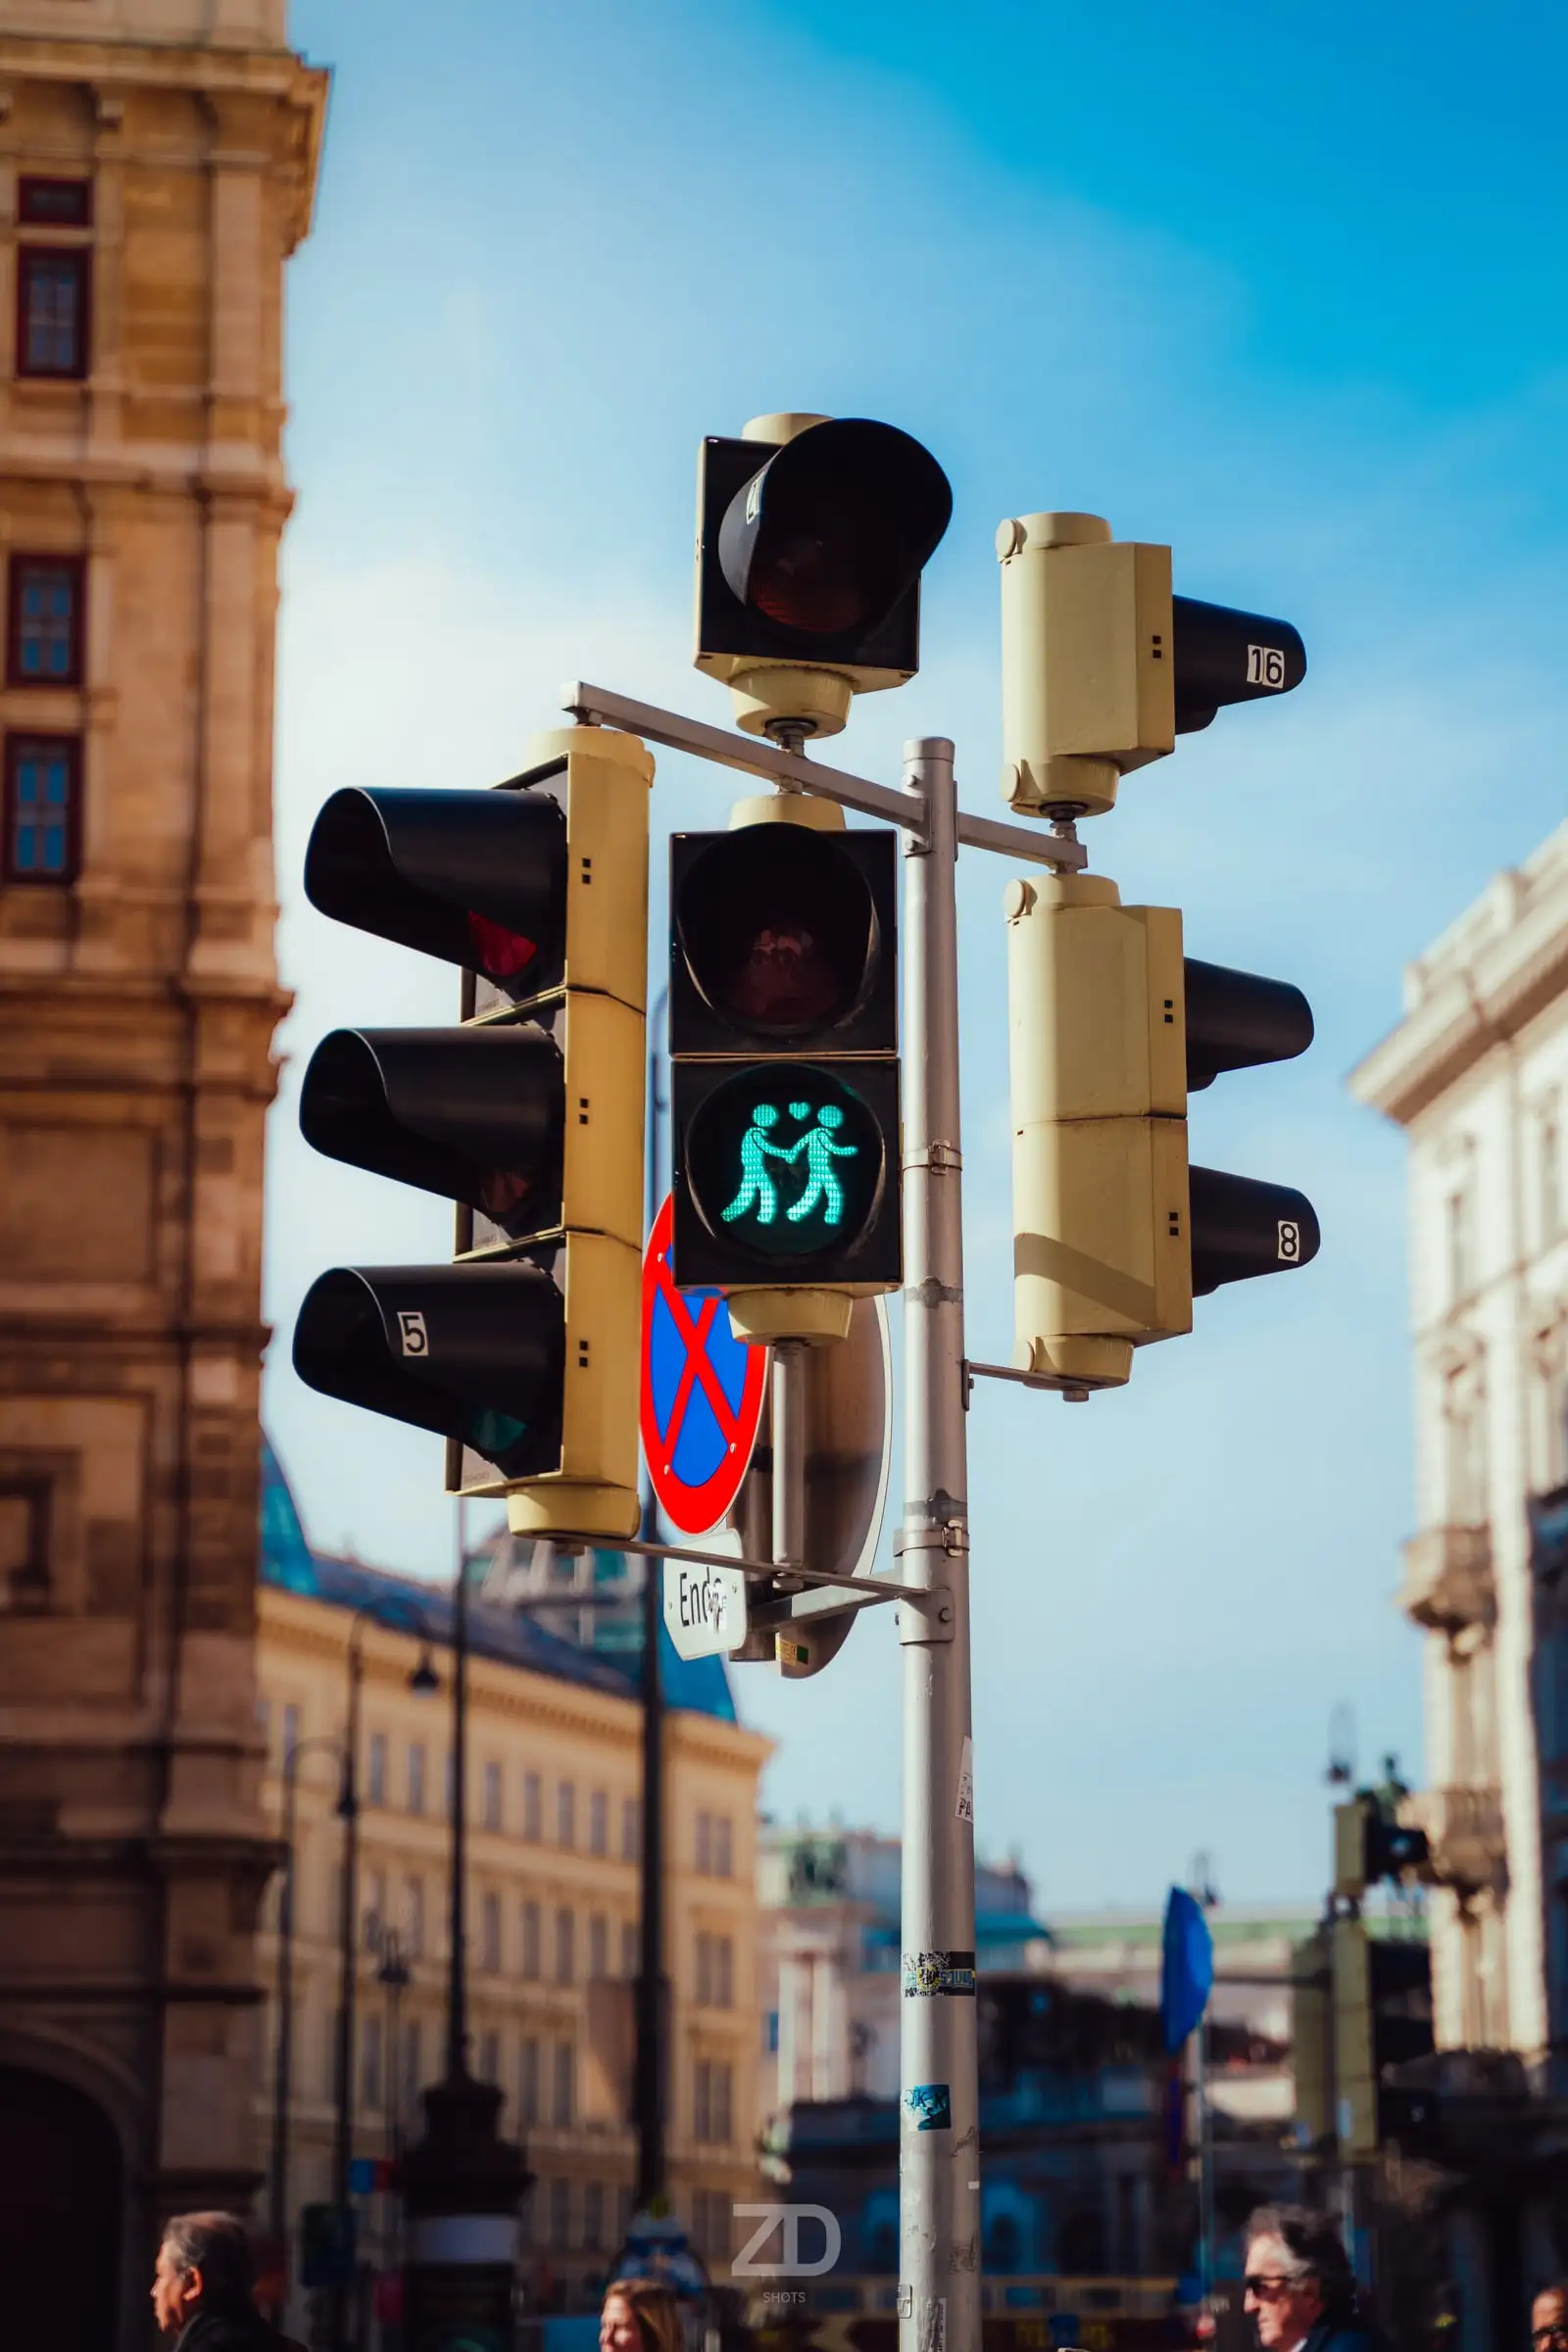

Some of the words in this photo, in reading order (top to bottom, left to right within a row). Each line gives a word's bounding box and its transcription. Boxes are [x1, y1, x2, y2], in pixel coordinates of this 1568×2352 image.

[1251, 648, 1283, 684] 16
[1280, 1223, 1298, 1257] 8
[401, 1314, 426, 1353] 5
[679, 1566, 722, 1627] End
